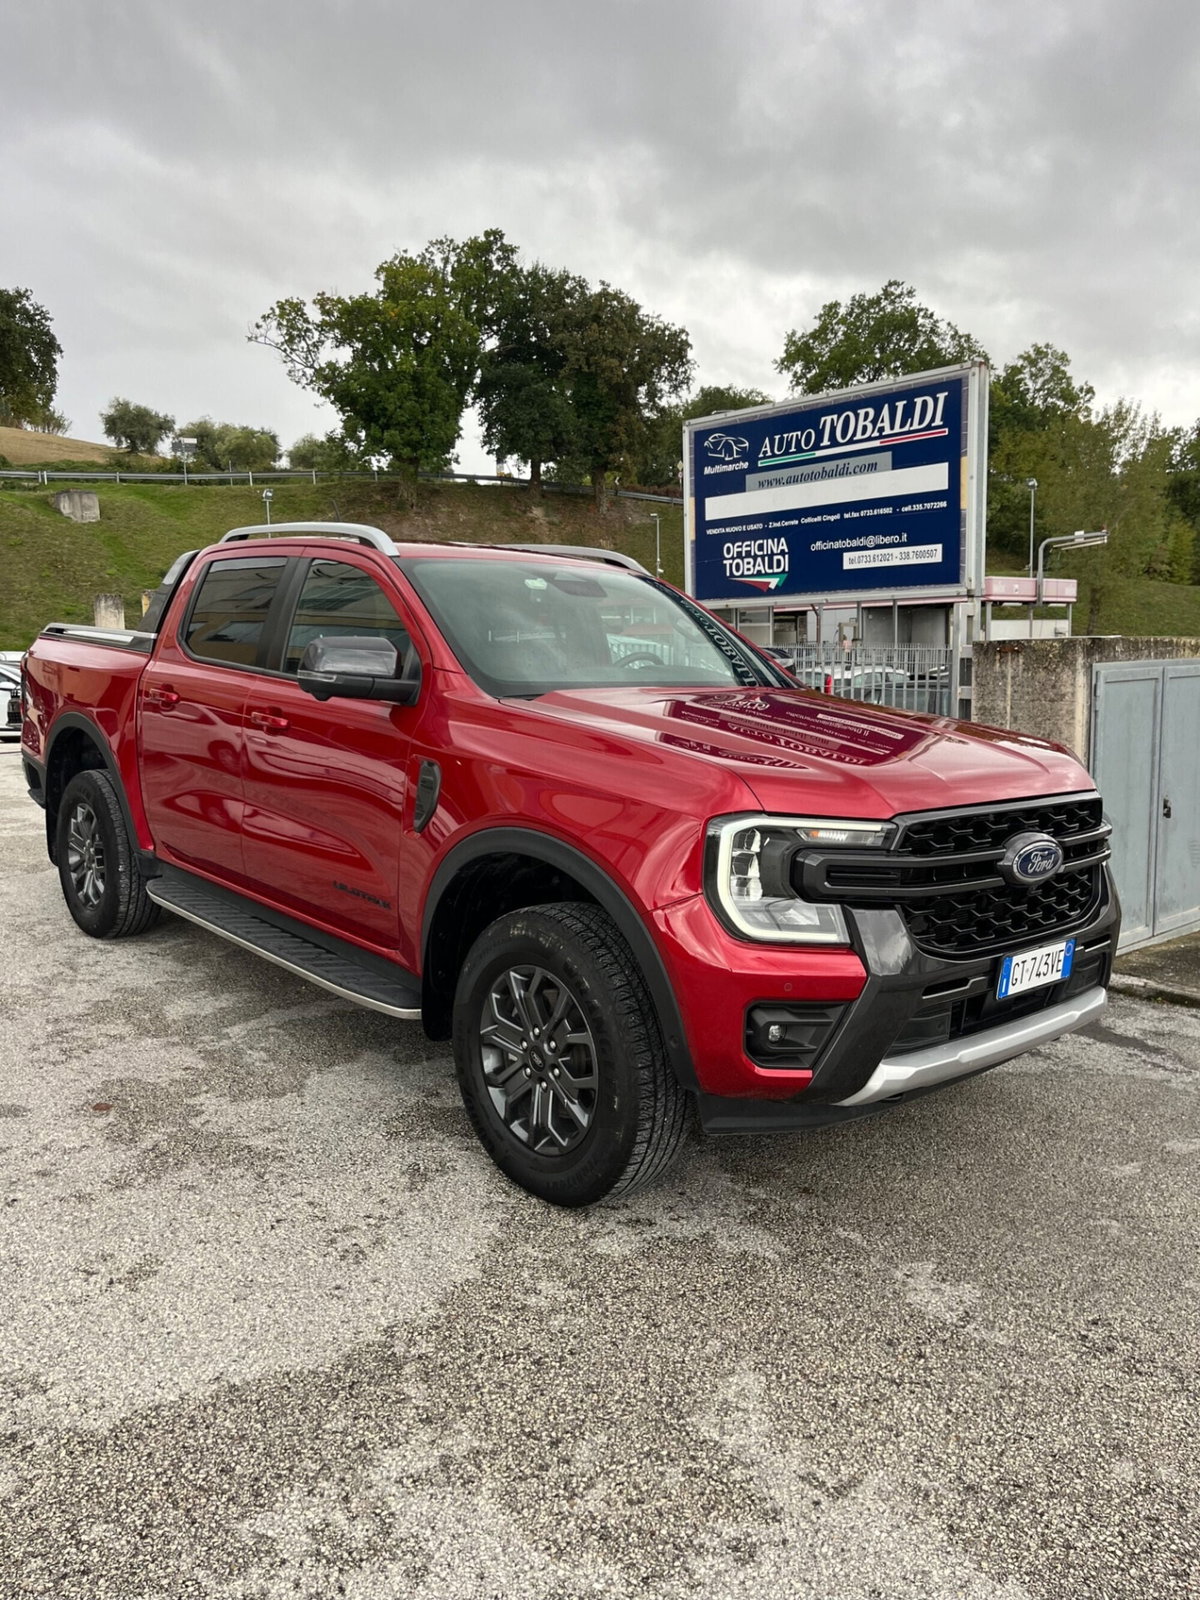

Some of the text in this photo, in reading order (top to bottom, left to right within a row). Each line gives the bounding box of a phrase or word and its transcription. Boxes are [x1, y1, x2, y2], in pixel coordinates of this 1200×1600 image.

[758, 391, 949, 458] AUTO TOBALDI
[703, 461, 749, 475] Multimarche
[758, 460, 878, 488] www.autotobaldi.com
[725, 525, 742, 533] NUOVO
[746, 523, 763, 531] USATO
[723, 536, 789, 559] OFFICINA
[810, 532, 908, 551] officinatobaldi@libero.it
[723, 554, 789, 577] TOBALDI
[899, 548, 938, 561] 338.7600507
[1027, 850, 1055, 874] Ford
